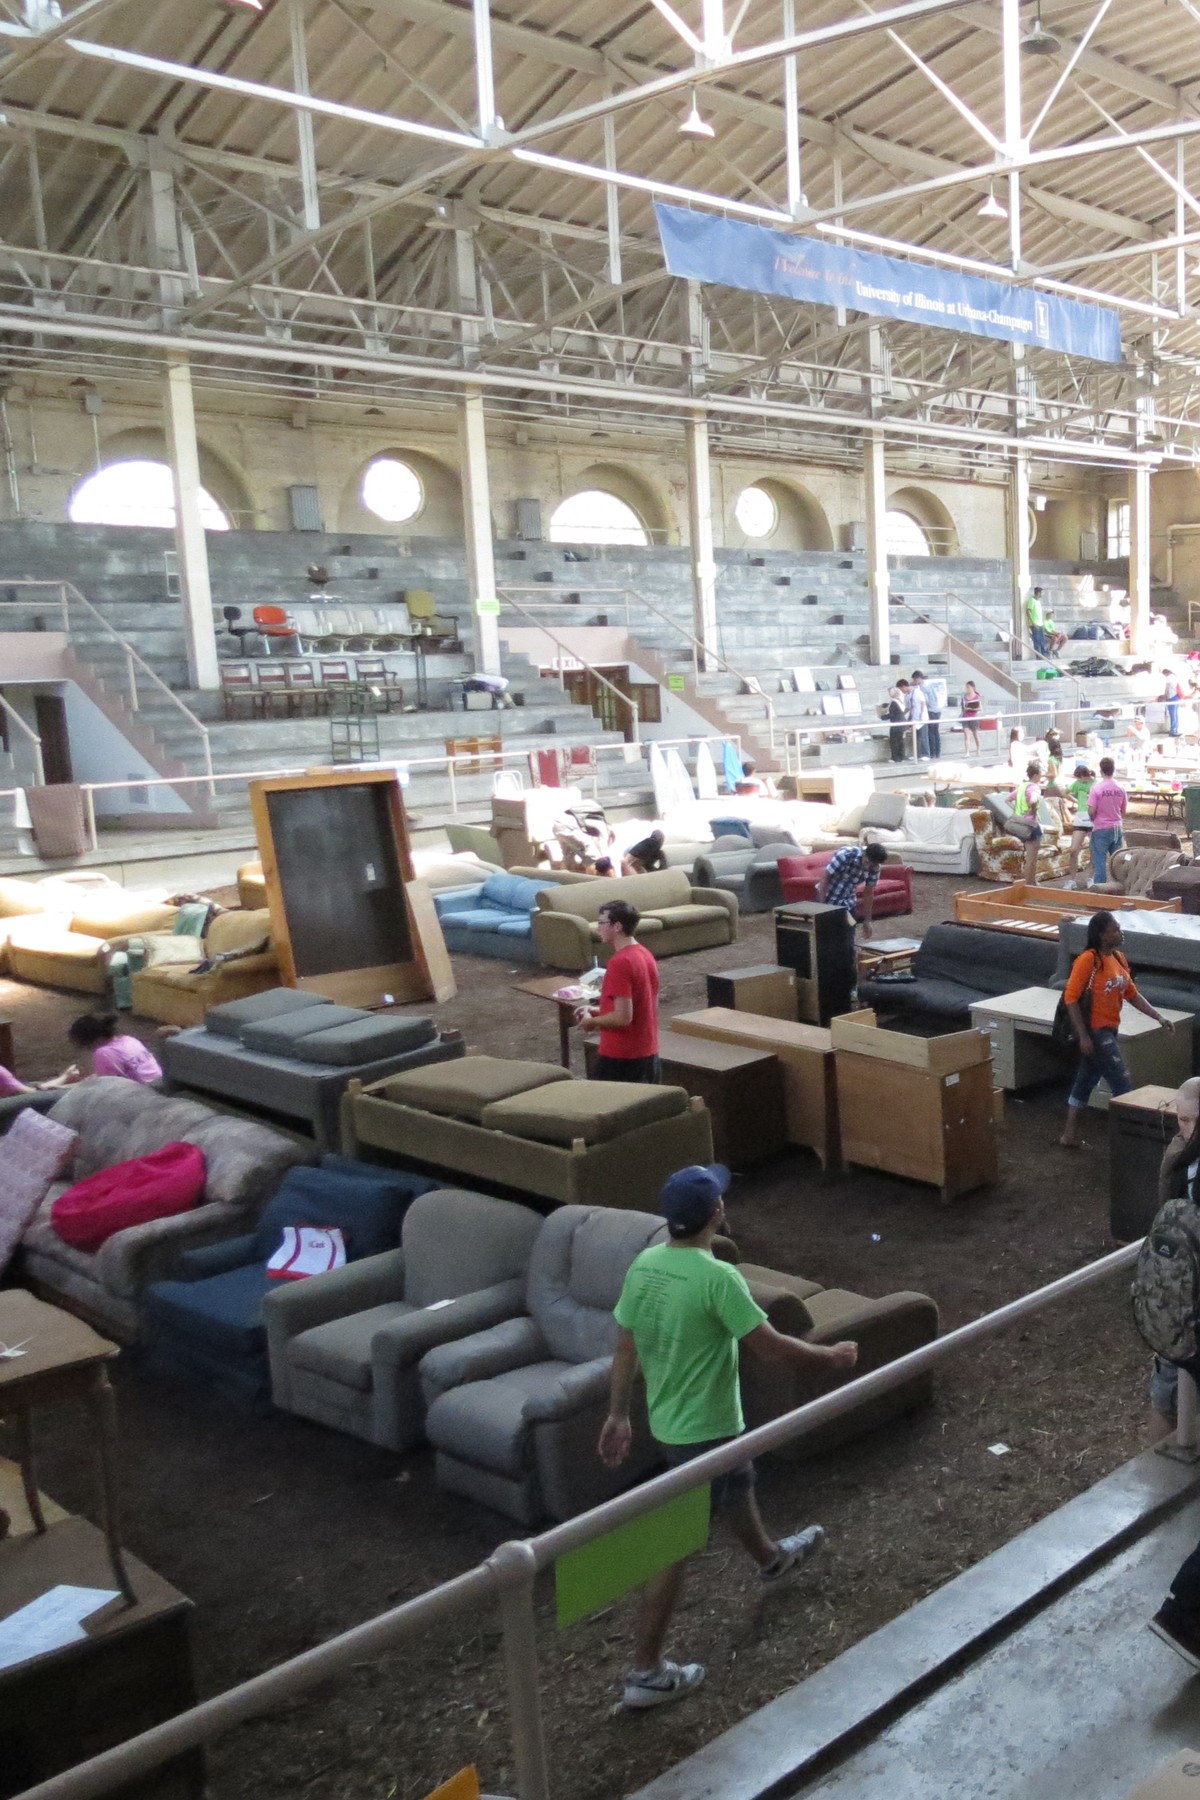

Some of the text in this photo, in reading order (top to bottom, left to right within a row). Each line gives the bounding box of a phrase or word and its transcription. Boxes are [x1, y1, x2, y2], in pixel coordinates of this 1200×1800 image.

[856, 281, 1033, 331] University of Illinois at Urbana-Champaign
[556, 659, 581, 668] EXIT
